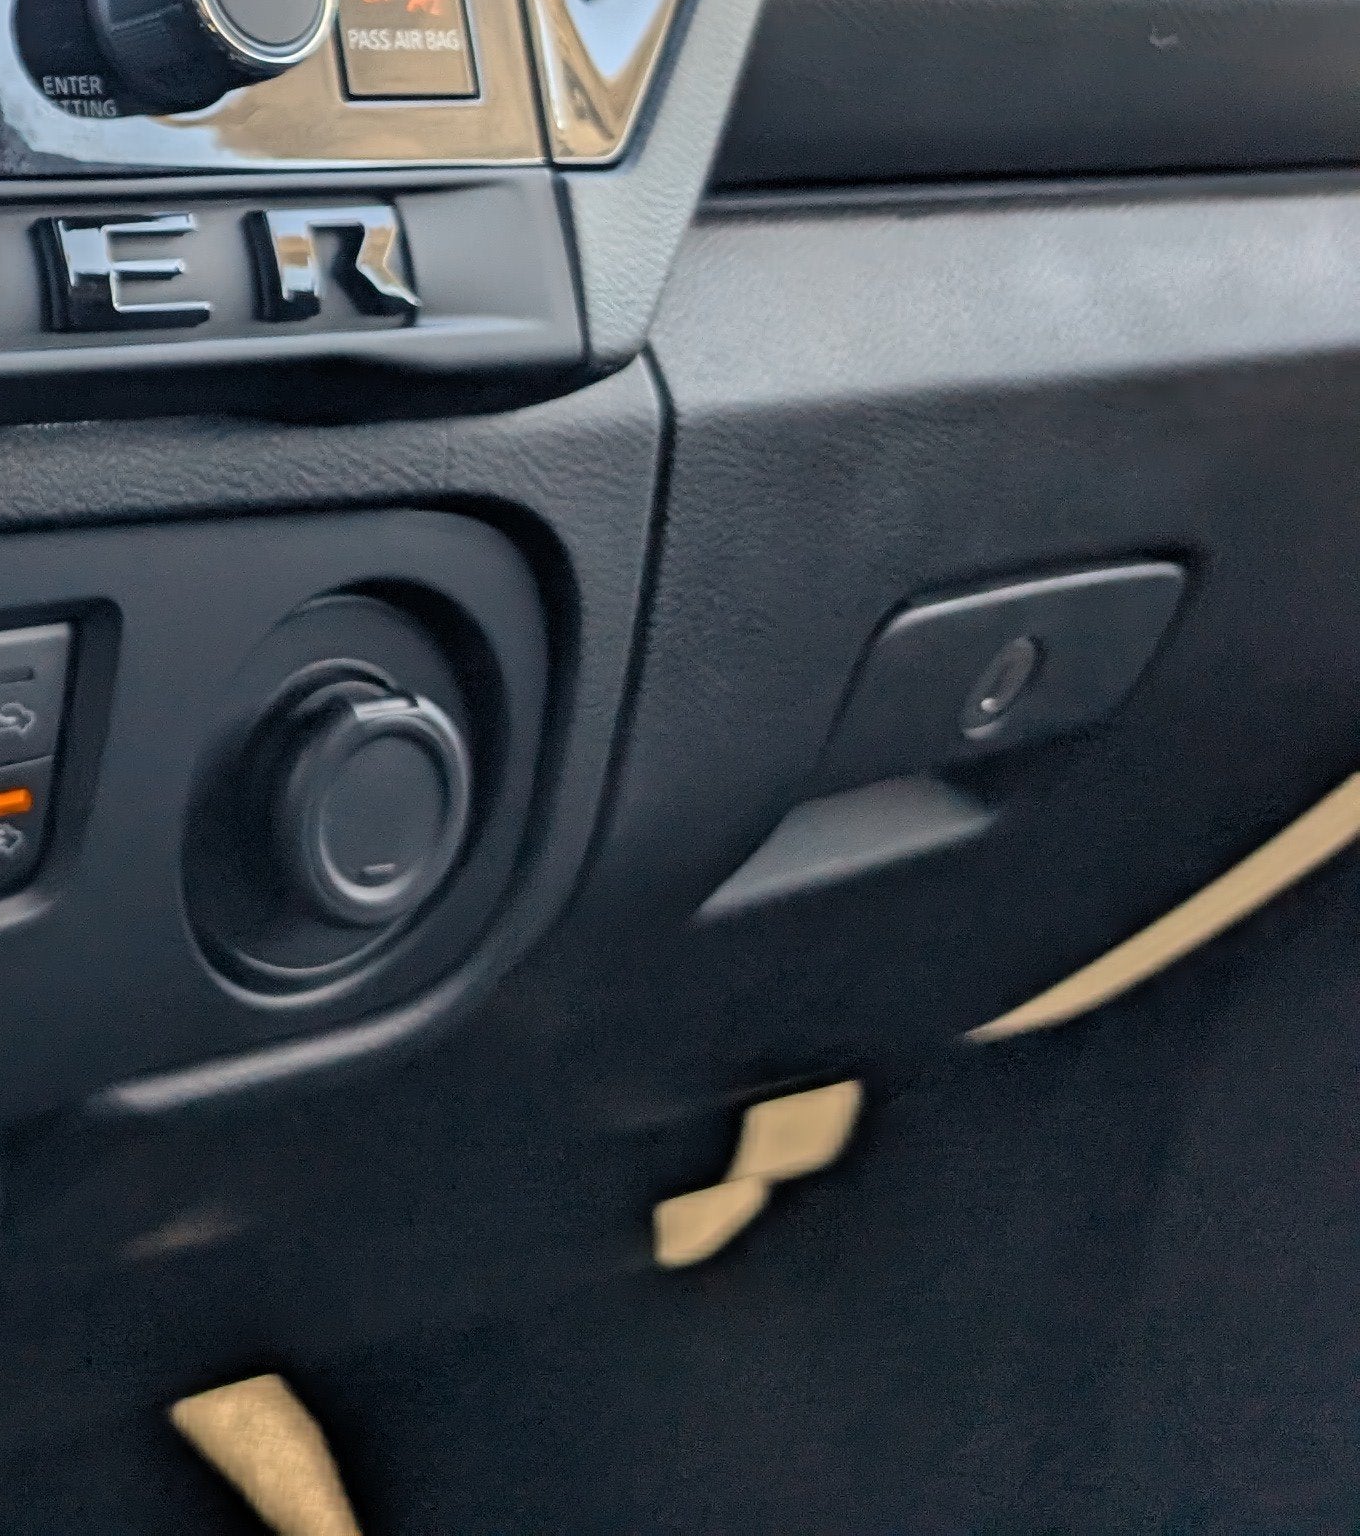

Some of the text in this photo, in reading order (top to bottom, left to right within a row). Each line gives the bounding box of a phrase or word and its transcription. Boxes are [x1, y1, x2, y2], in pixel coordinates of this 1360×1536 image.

[347, 28, 461, 51] PASS AIR BAG
[43, 74, 103, 96] ENTER
